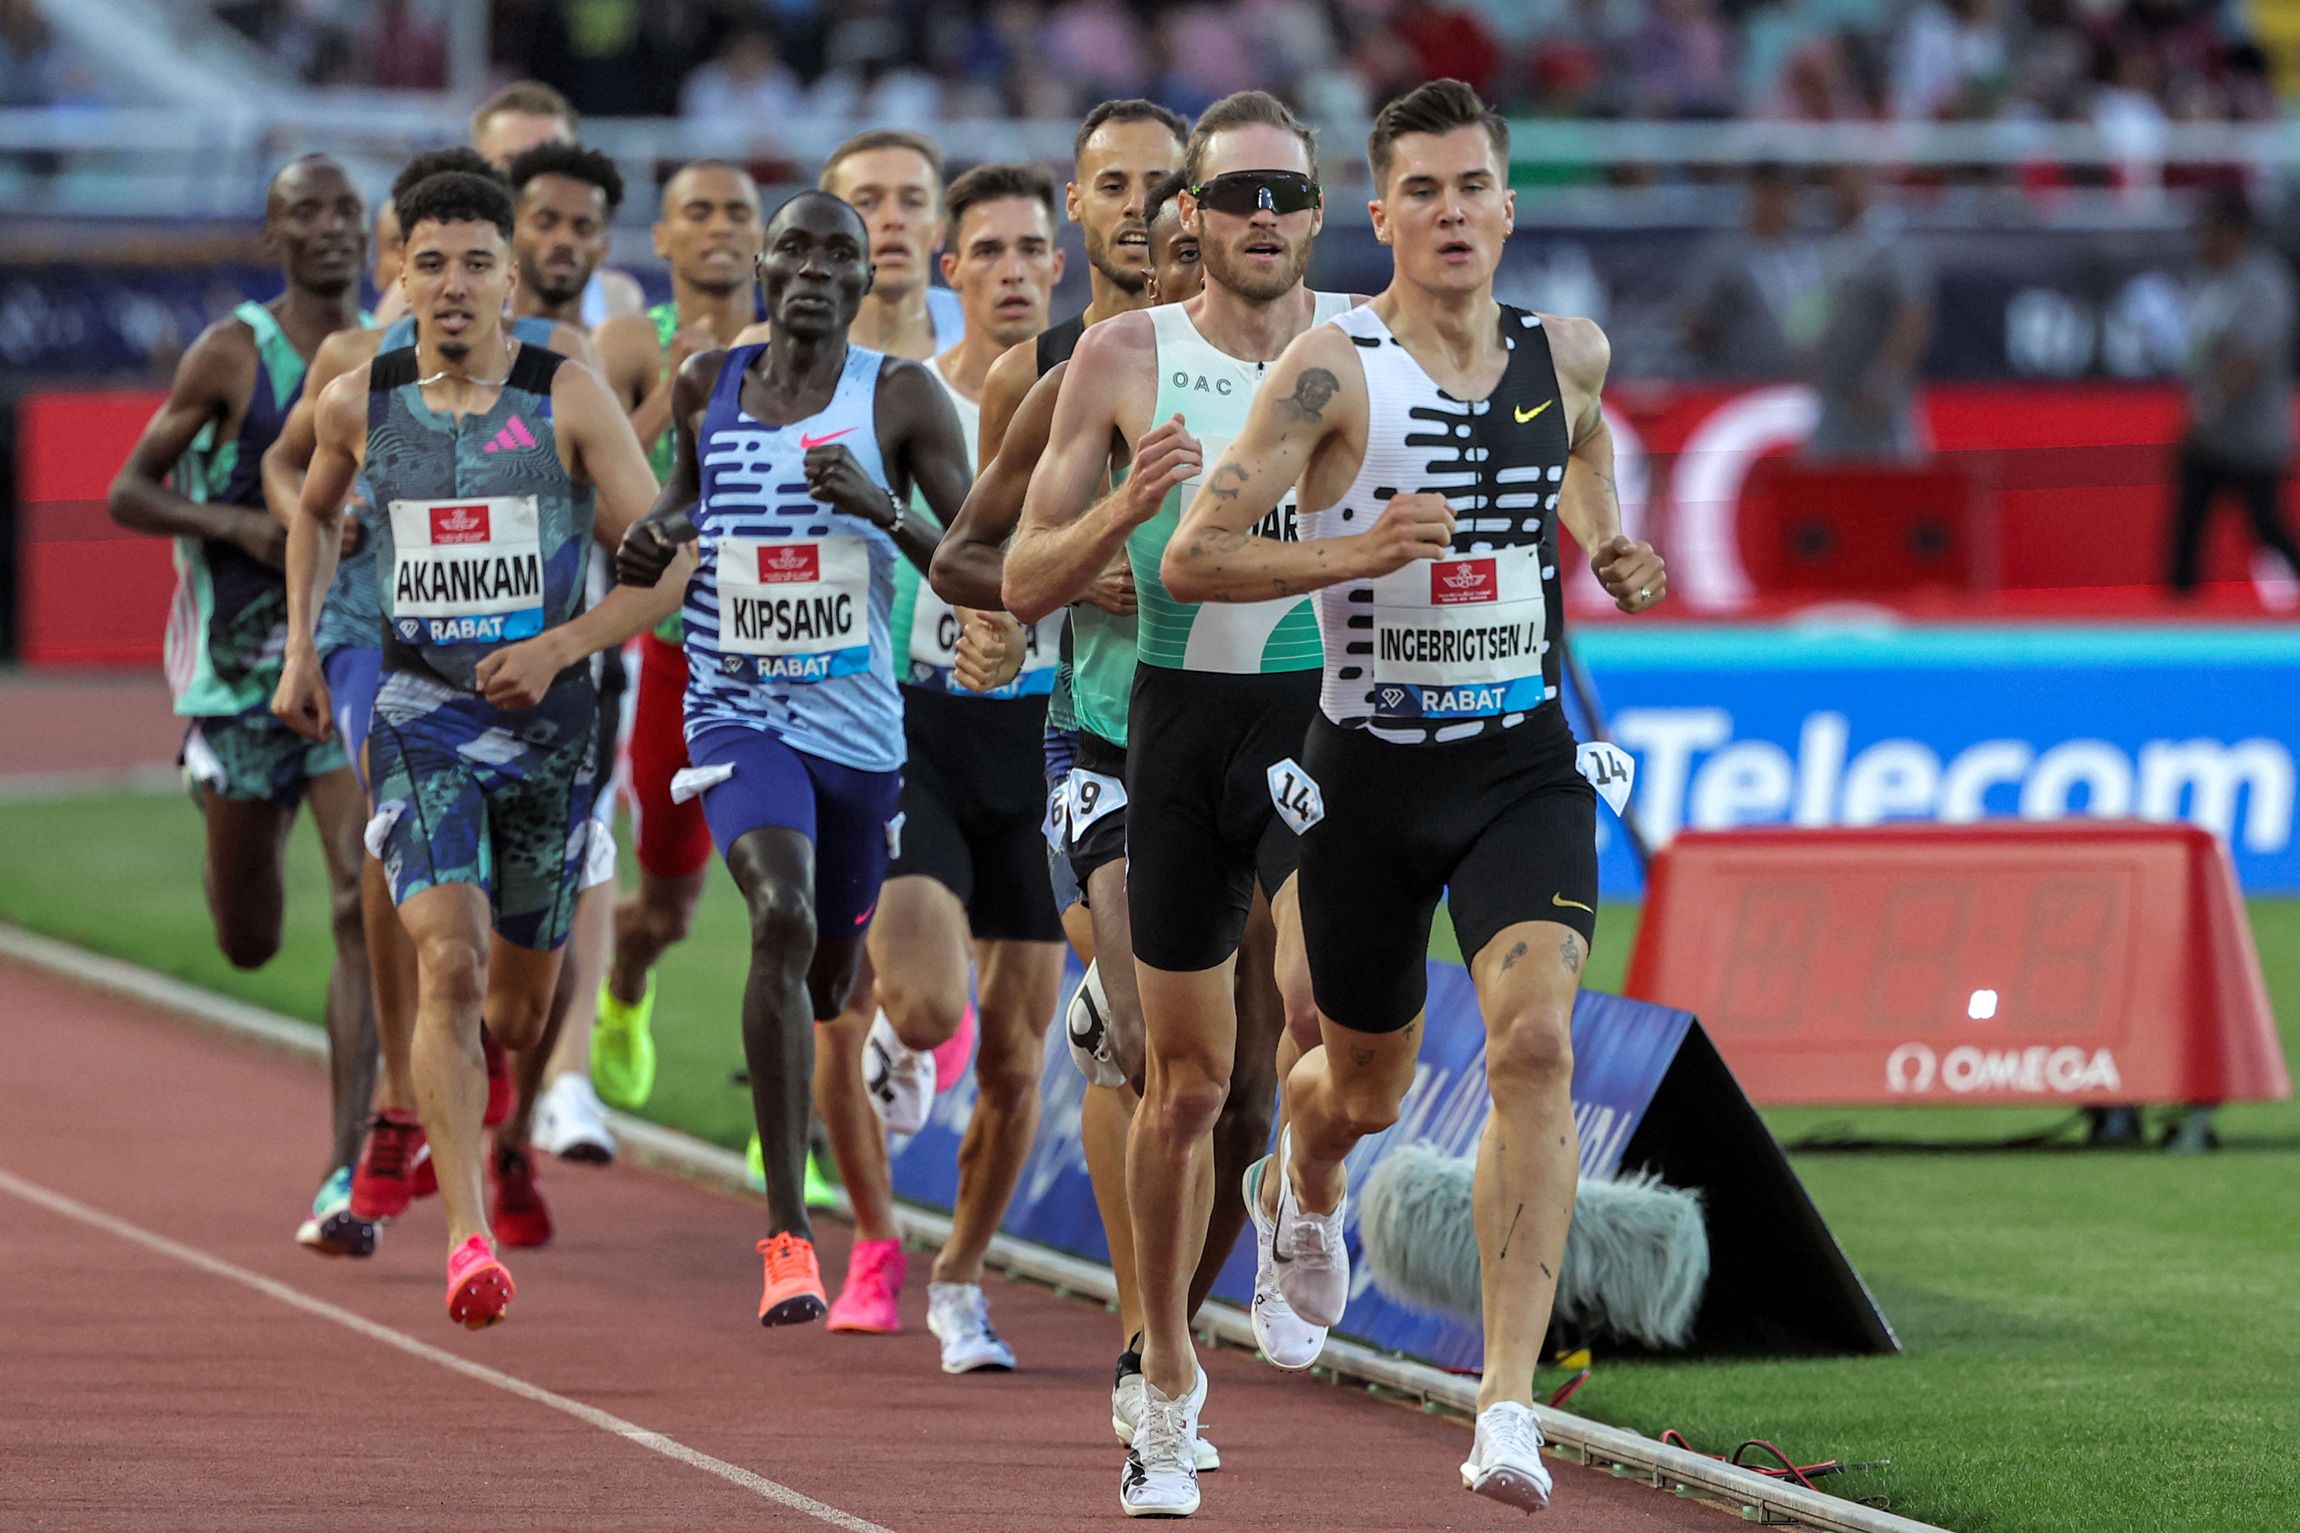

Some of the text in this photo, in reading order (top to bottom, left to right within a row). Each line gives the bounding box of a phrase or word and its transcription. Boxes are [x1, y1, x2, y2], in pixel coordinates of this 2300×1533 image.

[1172, 371, 1232, 396] OAC
[396, 553, 539, 603] AKANKAM
[429, 615, 504, 641] RABAT
[733, 593, 852, 641] KIPSANG
[1380, 621, 1538, 663] INGEBRIGTSEN J.
[756, 655, 832, 679] RABAT
[1421, 687, 1506, 713] RABAT
[1588, 750, 1628, 786] 14
[1610, 706, 2296, 854] Telecom
[1051, 796, 1064, 828] 6
[1080, 781, 1102, 815] 9
[1277, 771, 1310, 822] 14
[1940, 1044, 2122, 1093] OMEGA
